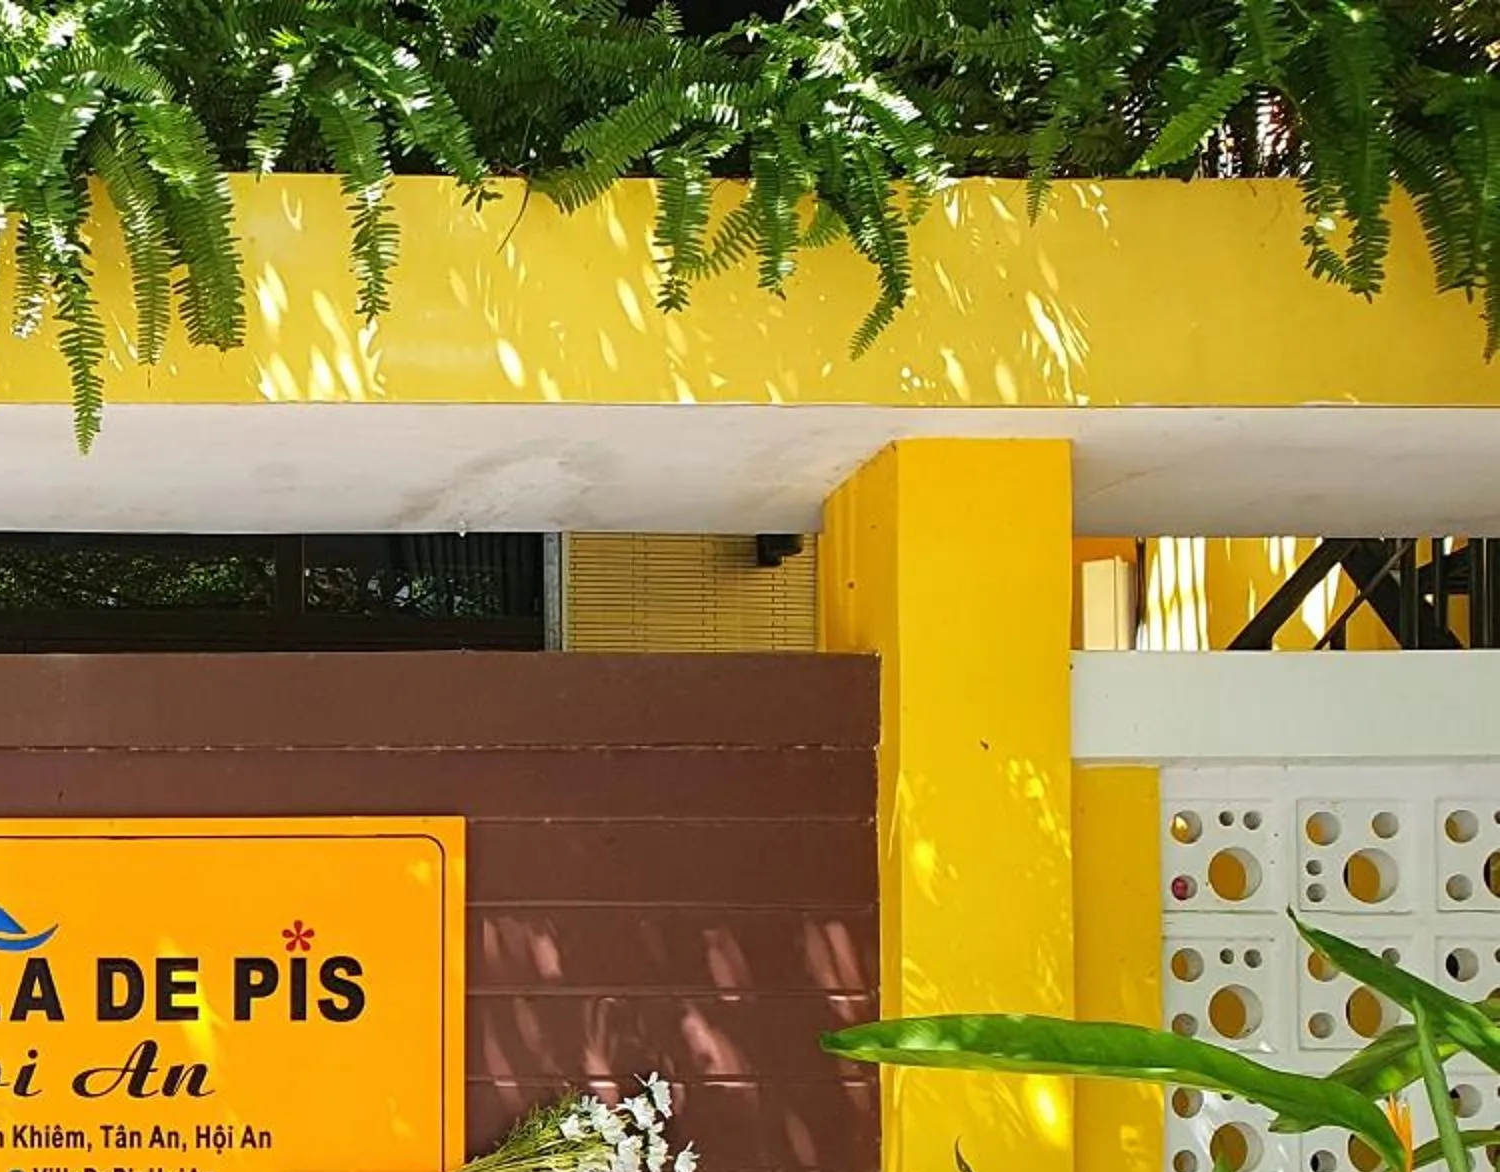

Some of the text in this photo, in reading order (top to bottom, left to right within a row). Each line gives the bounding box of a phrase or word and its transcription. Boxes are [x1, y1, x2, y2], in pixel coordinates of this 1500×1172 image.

[96, 956, 200, 1022] DE
[71, 1039, 215, 1099] An
[12, 1123, 93, 1153] Khiêm,
[99, 1124, 142, 1149] Tân
[148, 1124, 187, 1153] An,
[195, 1124, 234, 1155] Hội
[240, 1124, 273, 1149] An
